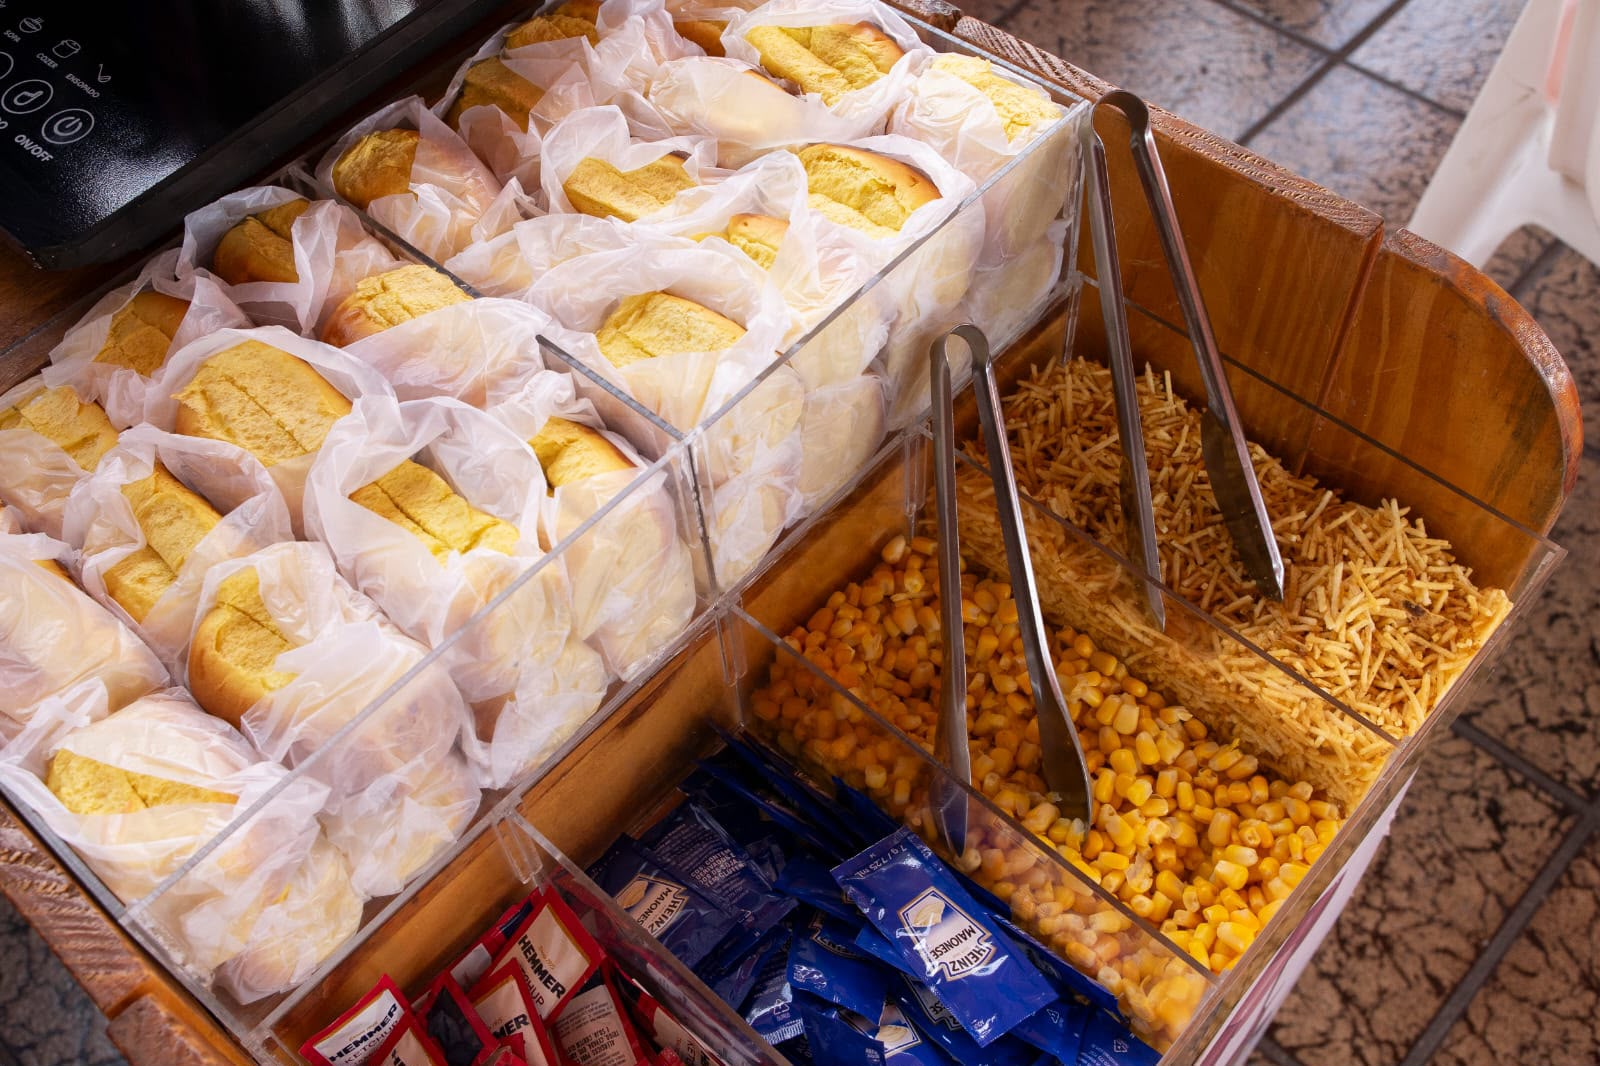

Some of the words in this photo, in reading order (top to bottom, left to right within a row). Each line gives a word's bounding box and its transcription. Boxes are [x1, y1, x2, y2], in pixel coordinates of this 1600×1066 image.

[36, 52, 59, 69] COZER
[65, 73, 100, 98] ENSOPADO
[14, 134, 54, 161] ON/OFF
[637, 887, 673, 926] MAIONES
[647, 900, 681, 934] HEINZ
[929, 925, 977, 960] MAIONESE
[948, 945, 987, 972] HEINZ
[517, 934, 566, 999] HEMMER
[328, 1003, 398, 1062] HEMMER
